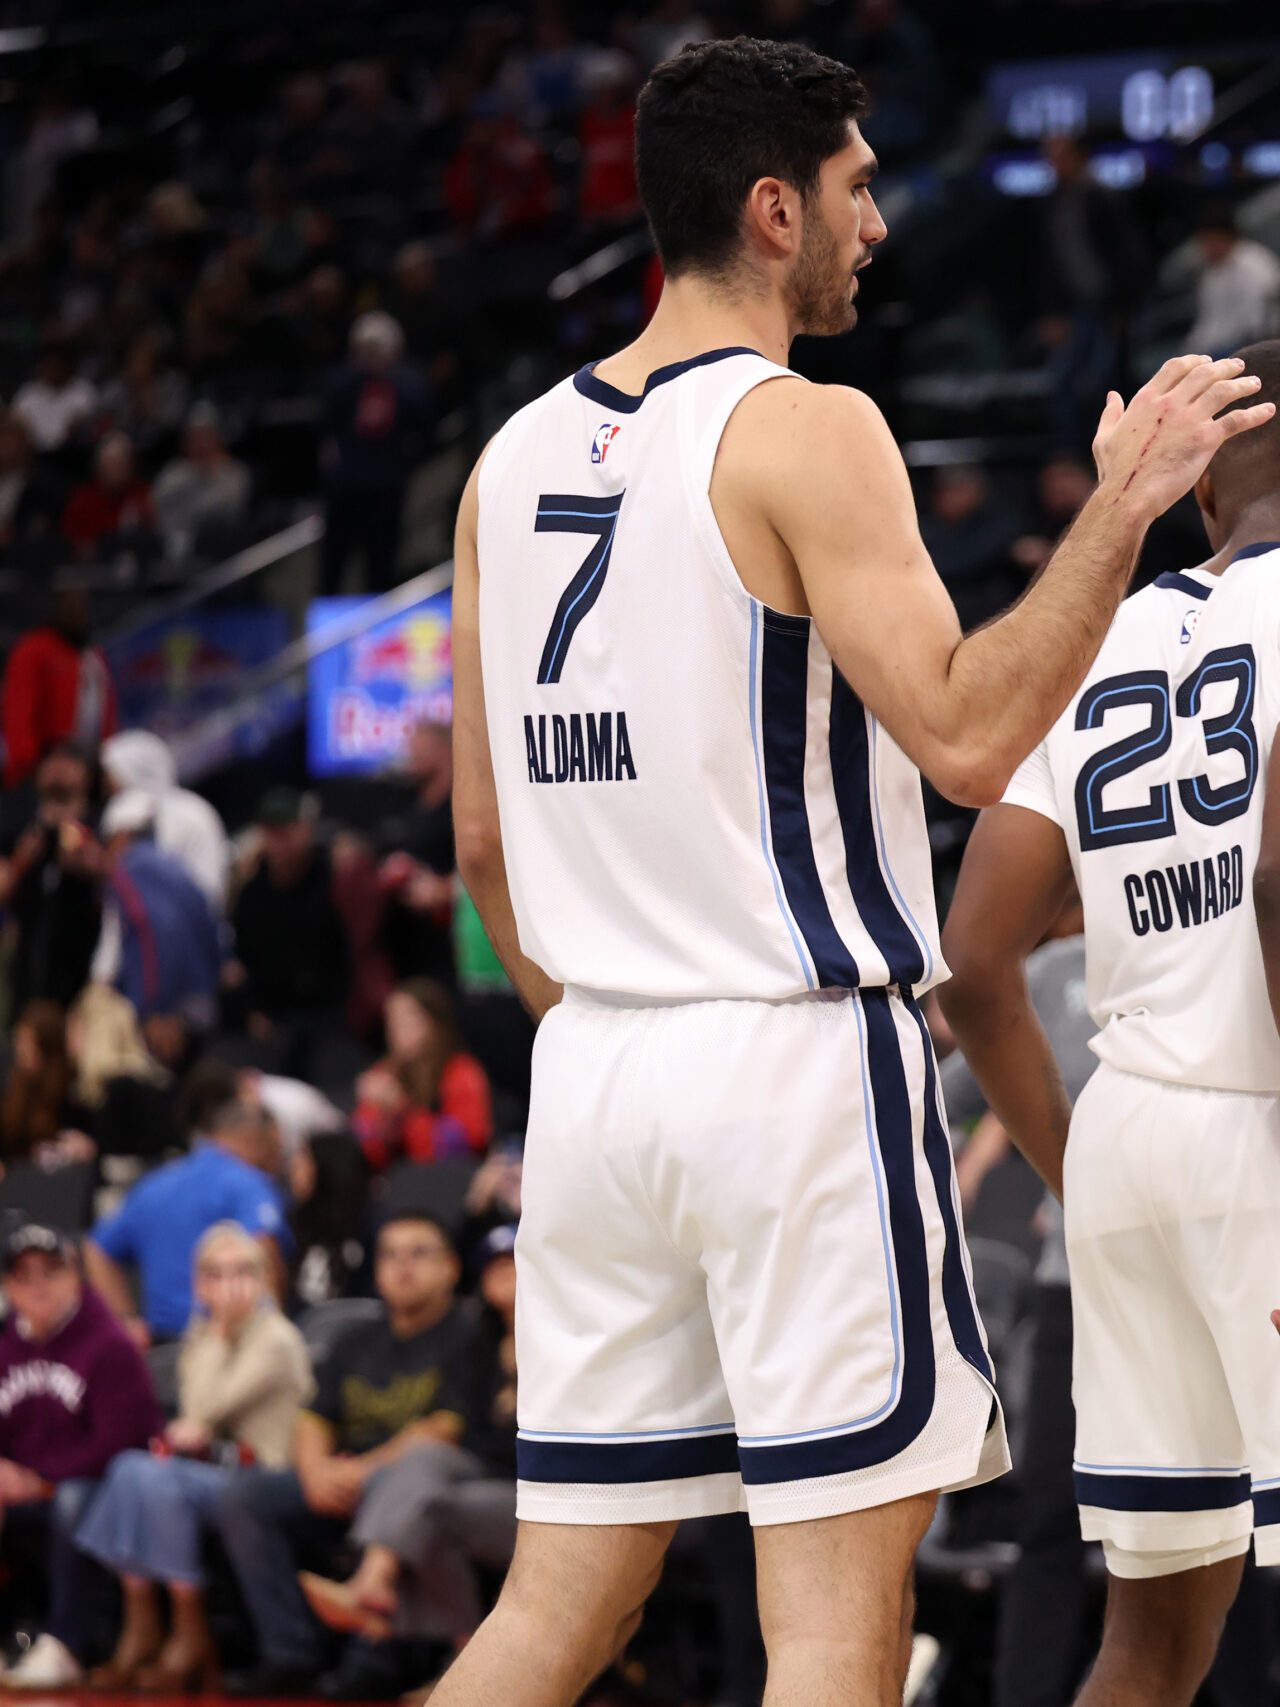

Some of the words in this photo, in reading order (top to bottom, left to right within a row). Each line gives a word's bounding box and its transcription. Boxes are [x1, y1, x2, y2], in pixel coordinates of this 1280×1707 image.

[534, 487, 626, 684] 7
[523, 711, 637, 783] ALDAMA
[1074, 643, 1259, 852] 23
[1124, 844, 1243, 937] COWARD
